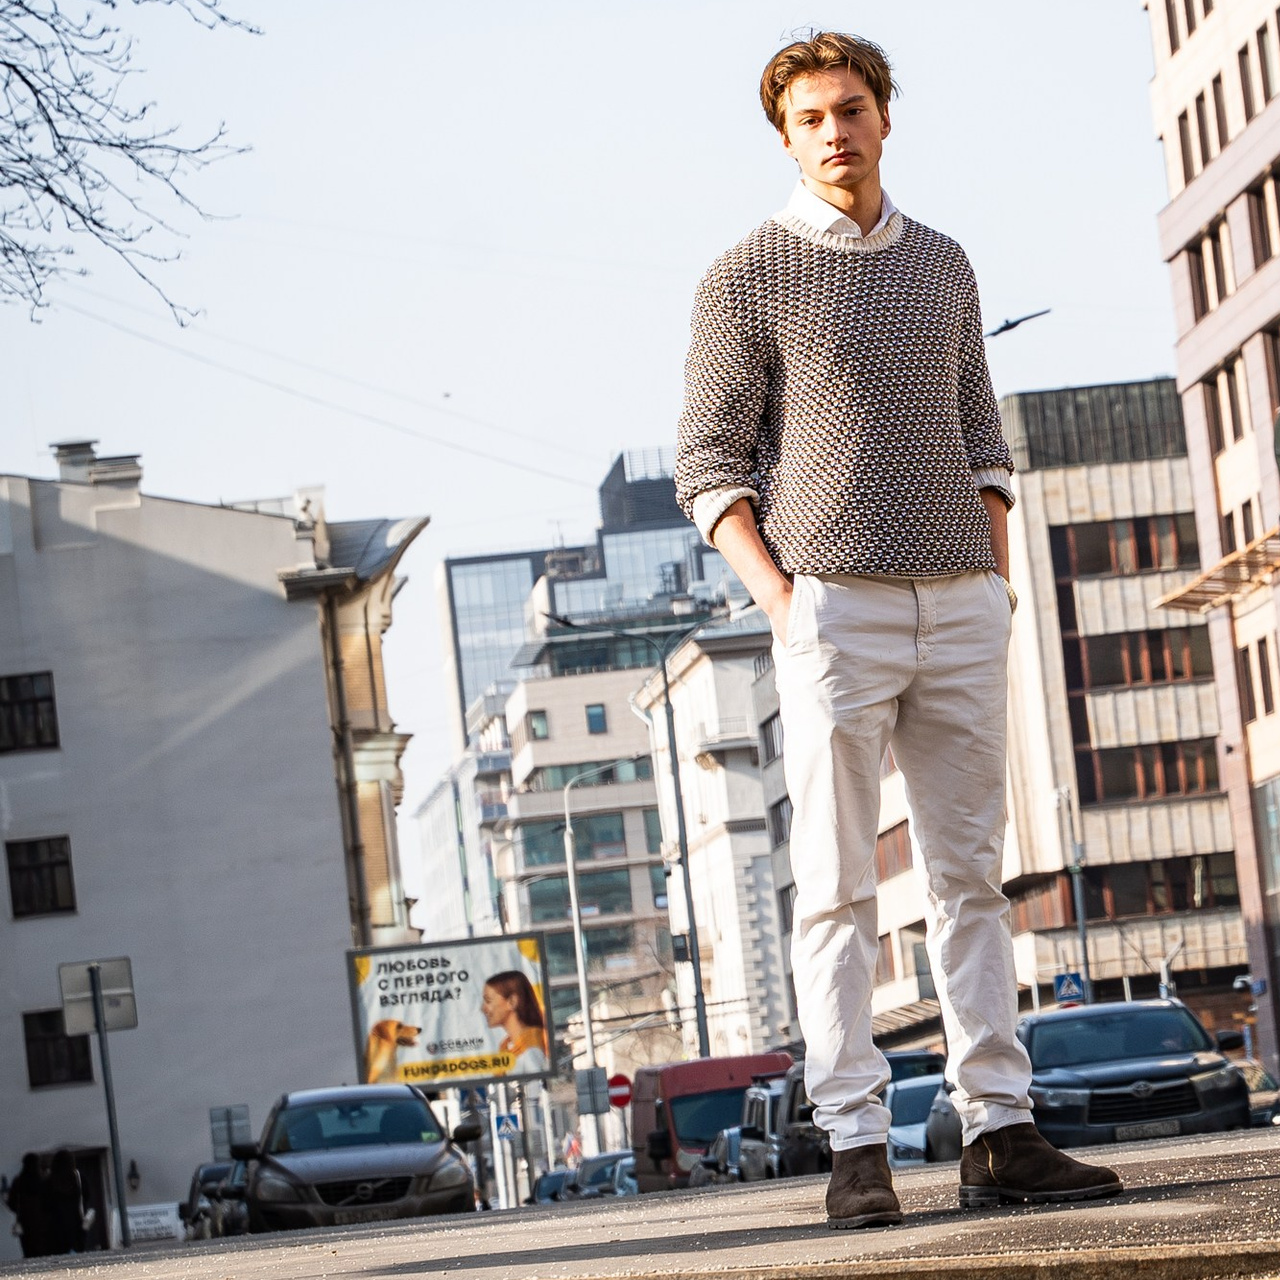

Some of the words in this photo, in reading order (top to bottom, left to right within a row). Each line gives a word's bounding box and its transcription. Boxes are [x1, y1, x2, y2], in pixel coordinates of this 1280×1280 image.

[377, 957, 451, 975] ЛЮБОВЬ
[378, 978, 389, 991] С
[393, 969, 469, 989] ПЕРВОГО
[379, 987, 462, 1007] ВЗГЛЯДА?
